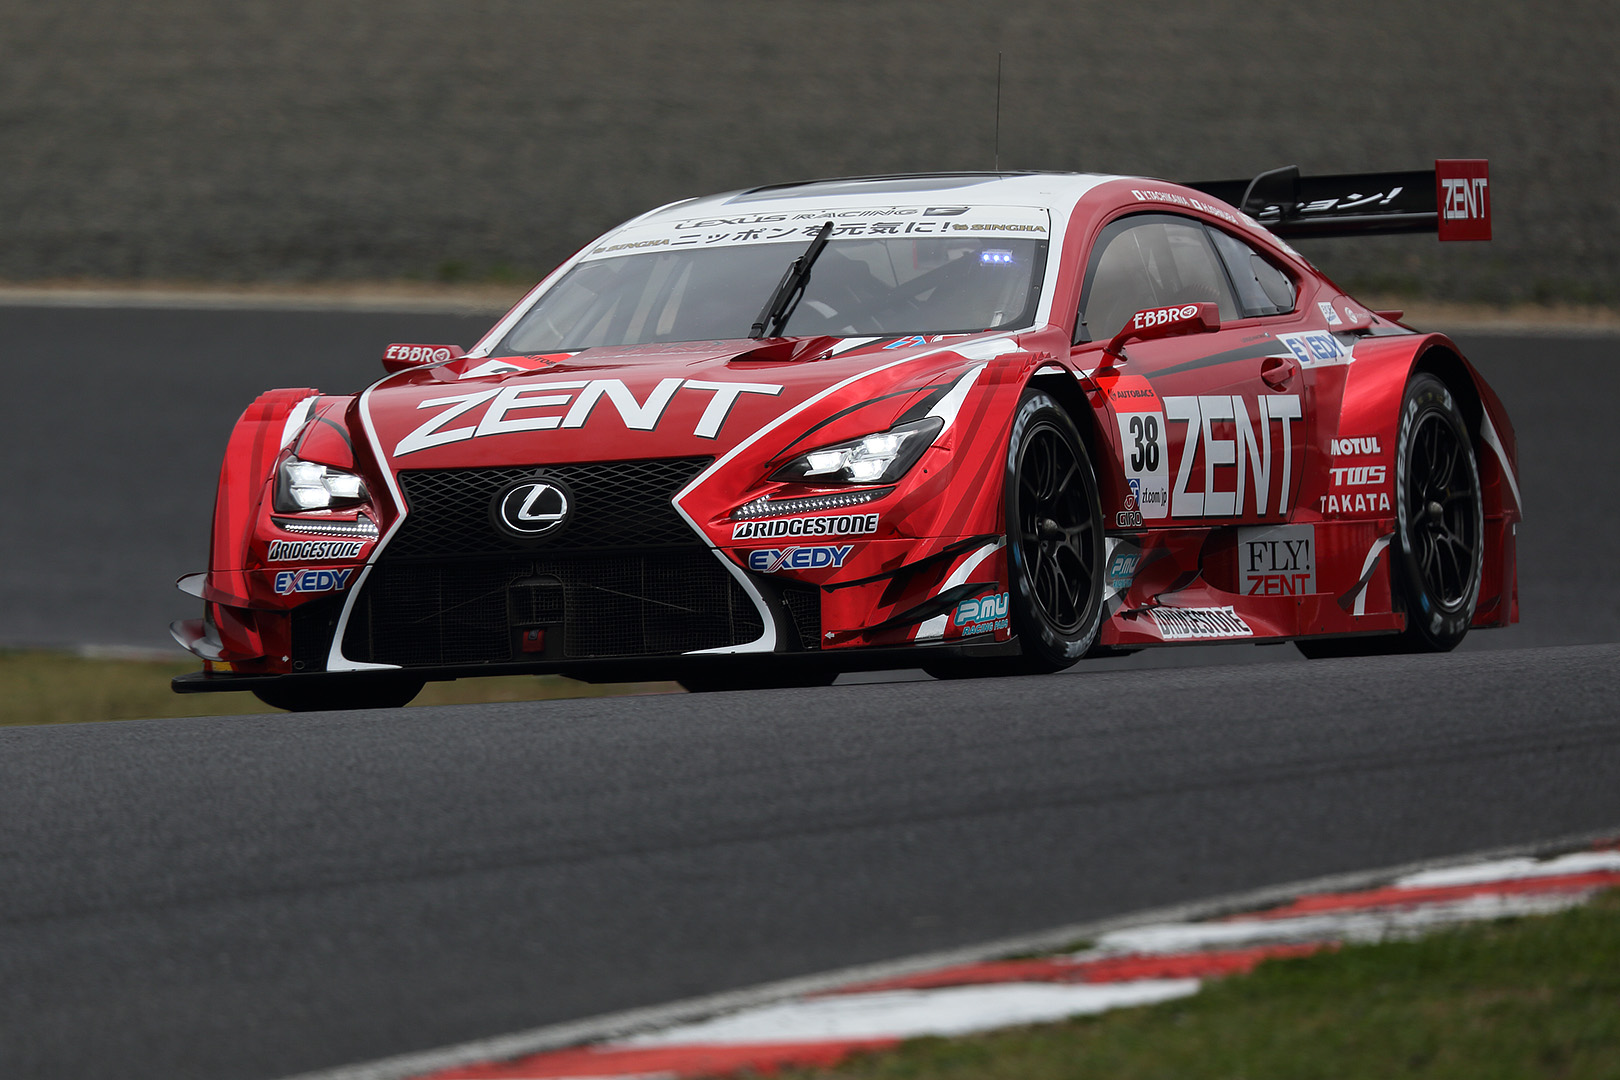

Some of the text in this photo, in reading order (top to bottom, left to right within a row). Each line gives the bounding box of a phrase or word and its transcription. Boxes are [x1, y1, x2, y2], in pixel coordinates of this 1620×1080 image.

[1441, 178, 1487, 219] ZENT
[675, 208, 918, 230] LEXUS RACING
[970, 223, 1047, 233] SINGHA
[1133, 305, 1198, 330] EBBRO
[386, 346, 451, 363] EBBRO
[1285, 334, 1344, 364] EXEDY
[1117, 389, 1155, 399] AUTOBACS
[393, 377, 785, 458] ZENT
[1128, 415, 1160, 472] 38
[1330, 437, 1381, 456] MOTUL
[1162, 394, 1303, 520] ZENT
[1329, 465, 1386, 486] TWS
[1320, 492, 1391, 514] TAKATA
[732, 513, 879, 540] BRIDGESTONE
[1116, 511, 1142, 527] GIRO
[268, 540, 367, 562] BRIDGESTONE
[749, 545, 855, 573] EXEDY
[1246, 539, 1311, 572] FLY!
[274, 569, 354, 595] EXEDY
[1246, 573, 1311, 596] ZENT
[962, 621, 993, 636] RACING
[1148, 606, 1252, 638] BRIDGESTONE
